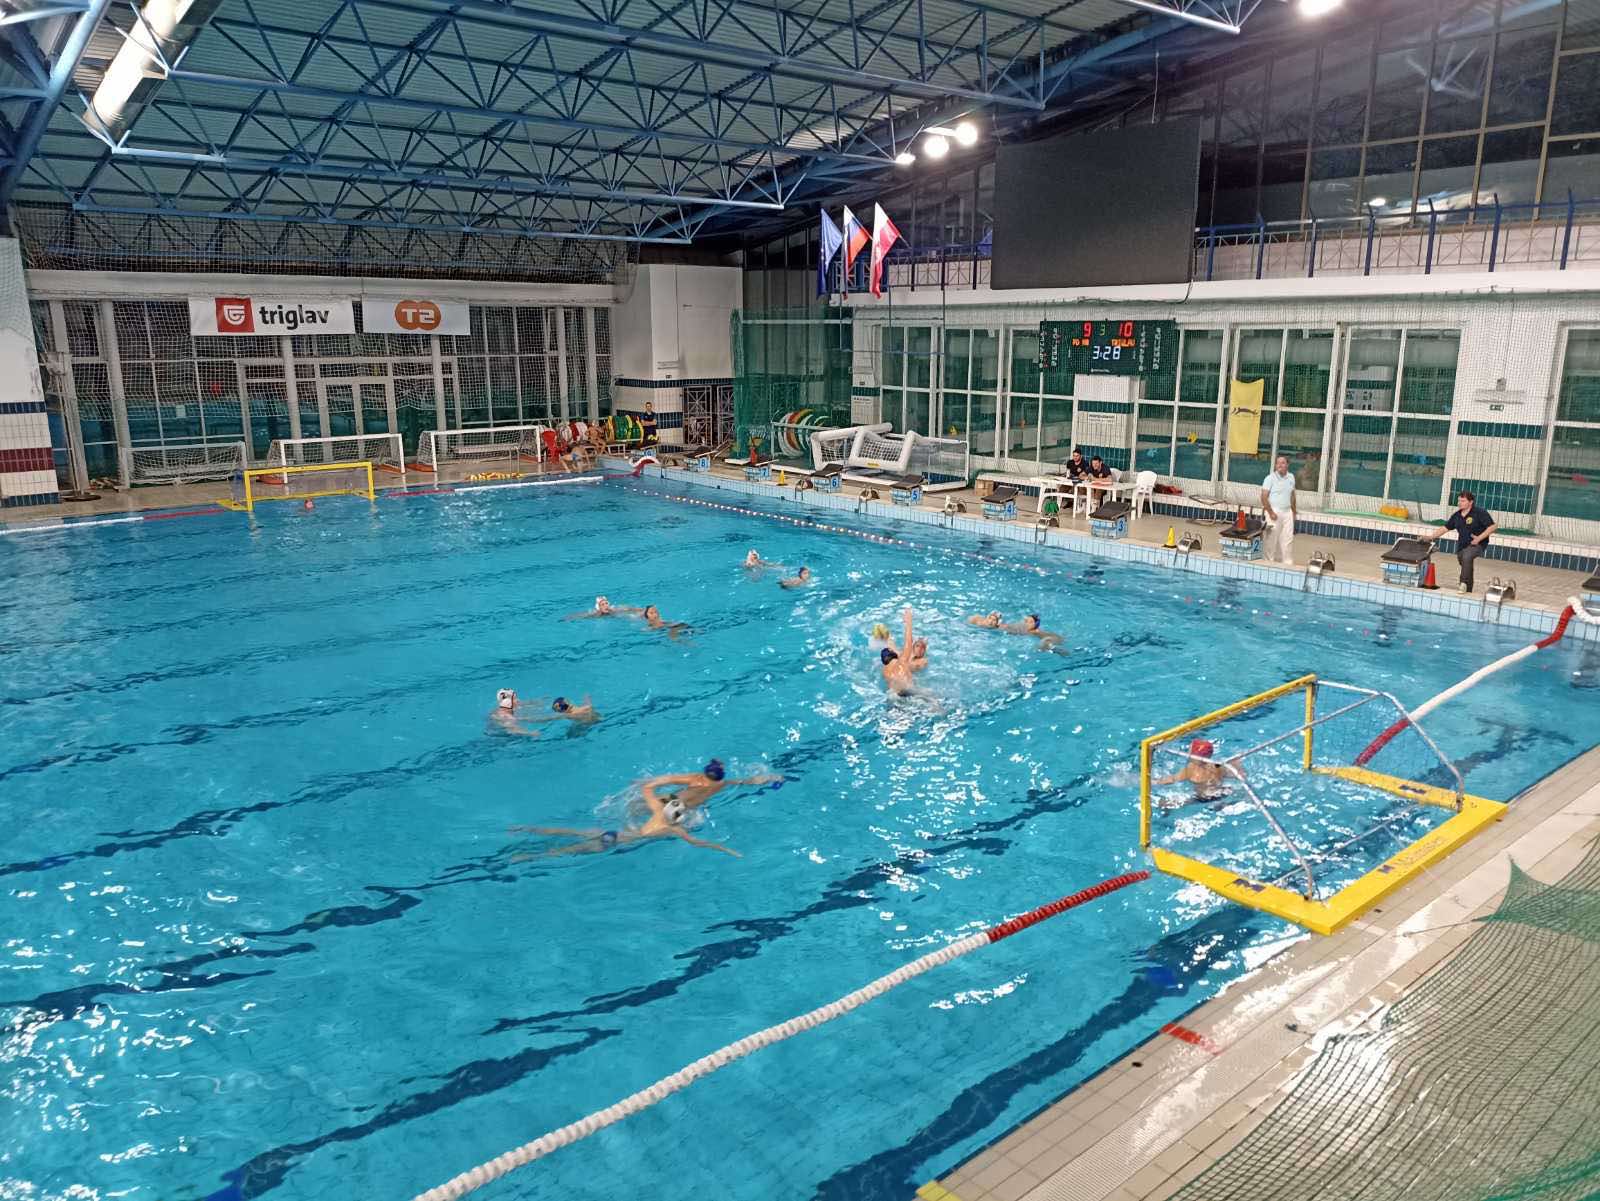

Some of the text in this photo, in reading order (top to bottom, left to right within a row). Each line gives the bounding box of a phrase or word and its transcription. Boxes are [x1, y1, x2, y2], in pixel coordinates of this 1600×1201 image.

[259, 304, 330, 331] triglav
[401, 308, 435, 323] T2
[1083, 322, 1092, 337] 9
[1119, 322, 1133, 337] 10
[1093, 345, 1121, 360] 3:28
[911, 489, 918, 500] 5
[1117, 519, 1124, 532] 3
[1253, 539, 1260, 553] 2
